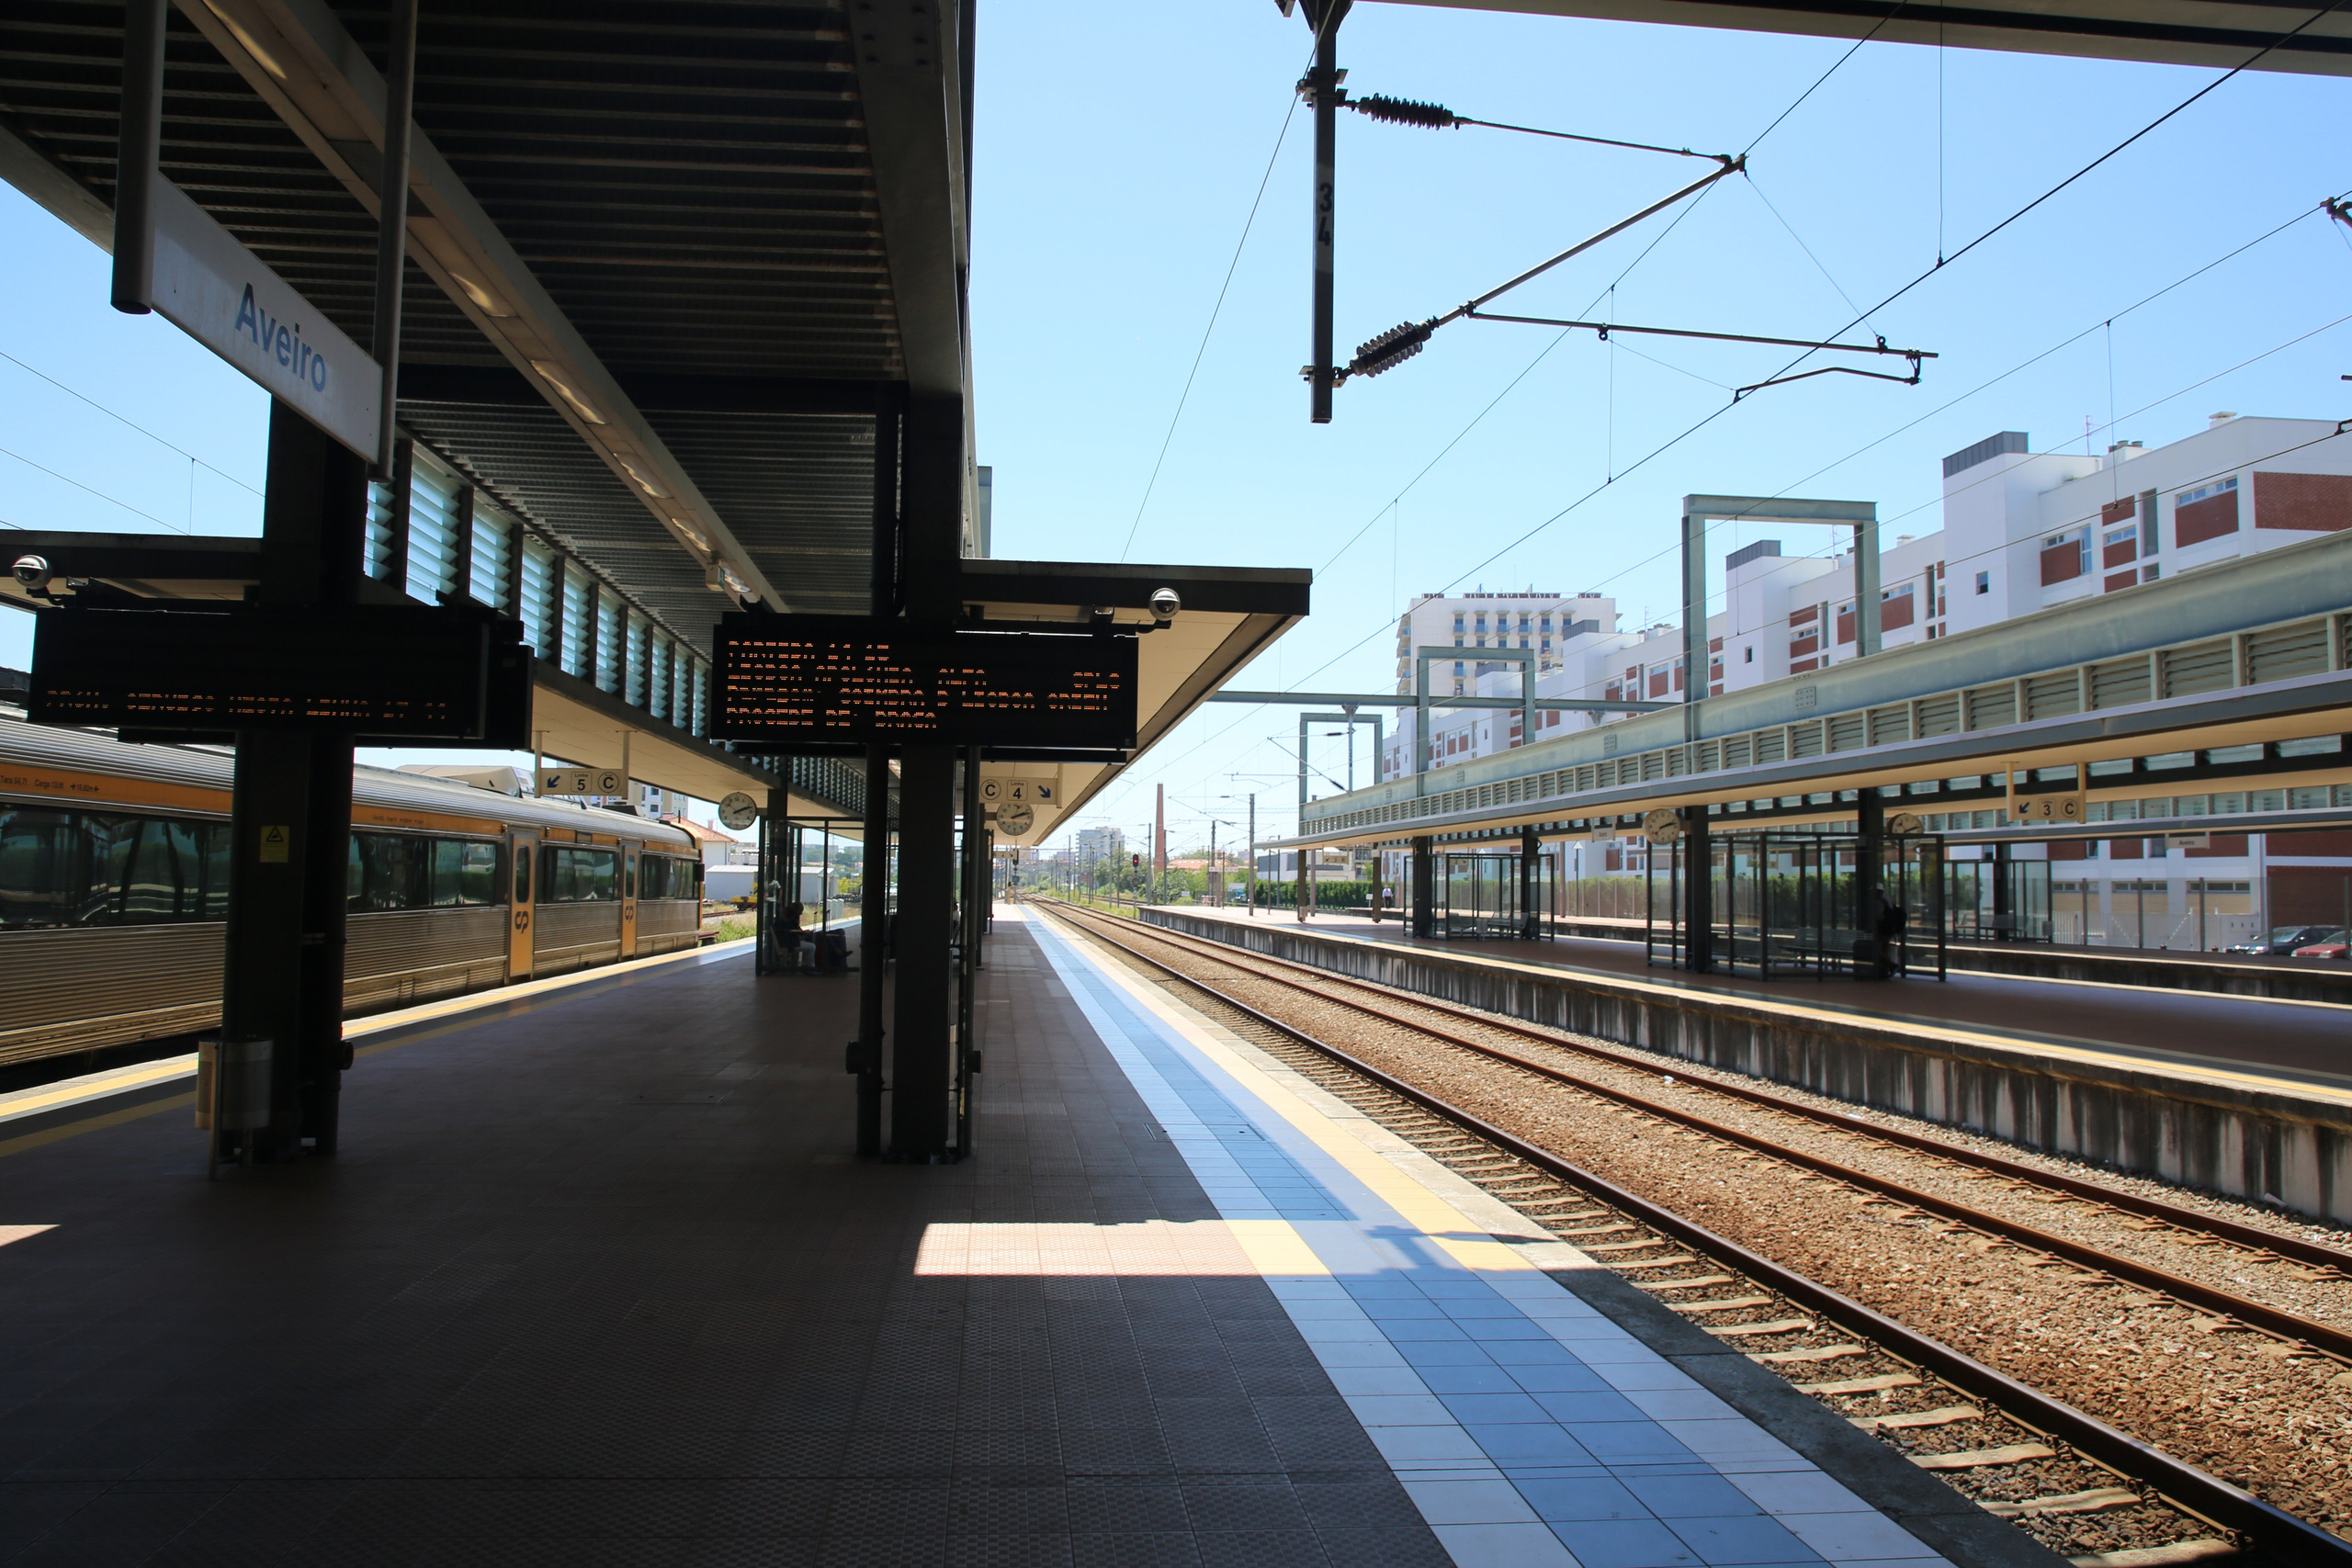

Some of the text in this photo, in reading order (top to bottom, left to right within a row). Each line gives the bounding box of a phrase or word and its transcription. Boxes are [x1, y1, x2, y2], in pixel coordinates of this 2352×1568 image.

[1317, 182, 1333, 246] 34
[235, 282, 326, 392] Aveiro
[577, 779, 585, 791] 5
[603, 776, 615, 789] C
[985, 784, 996, 796] C
[1012, 787, 1022, 799] 4
[2043, 804, 2051, 817] 3
[2064, 803, 2074, 815] C
